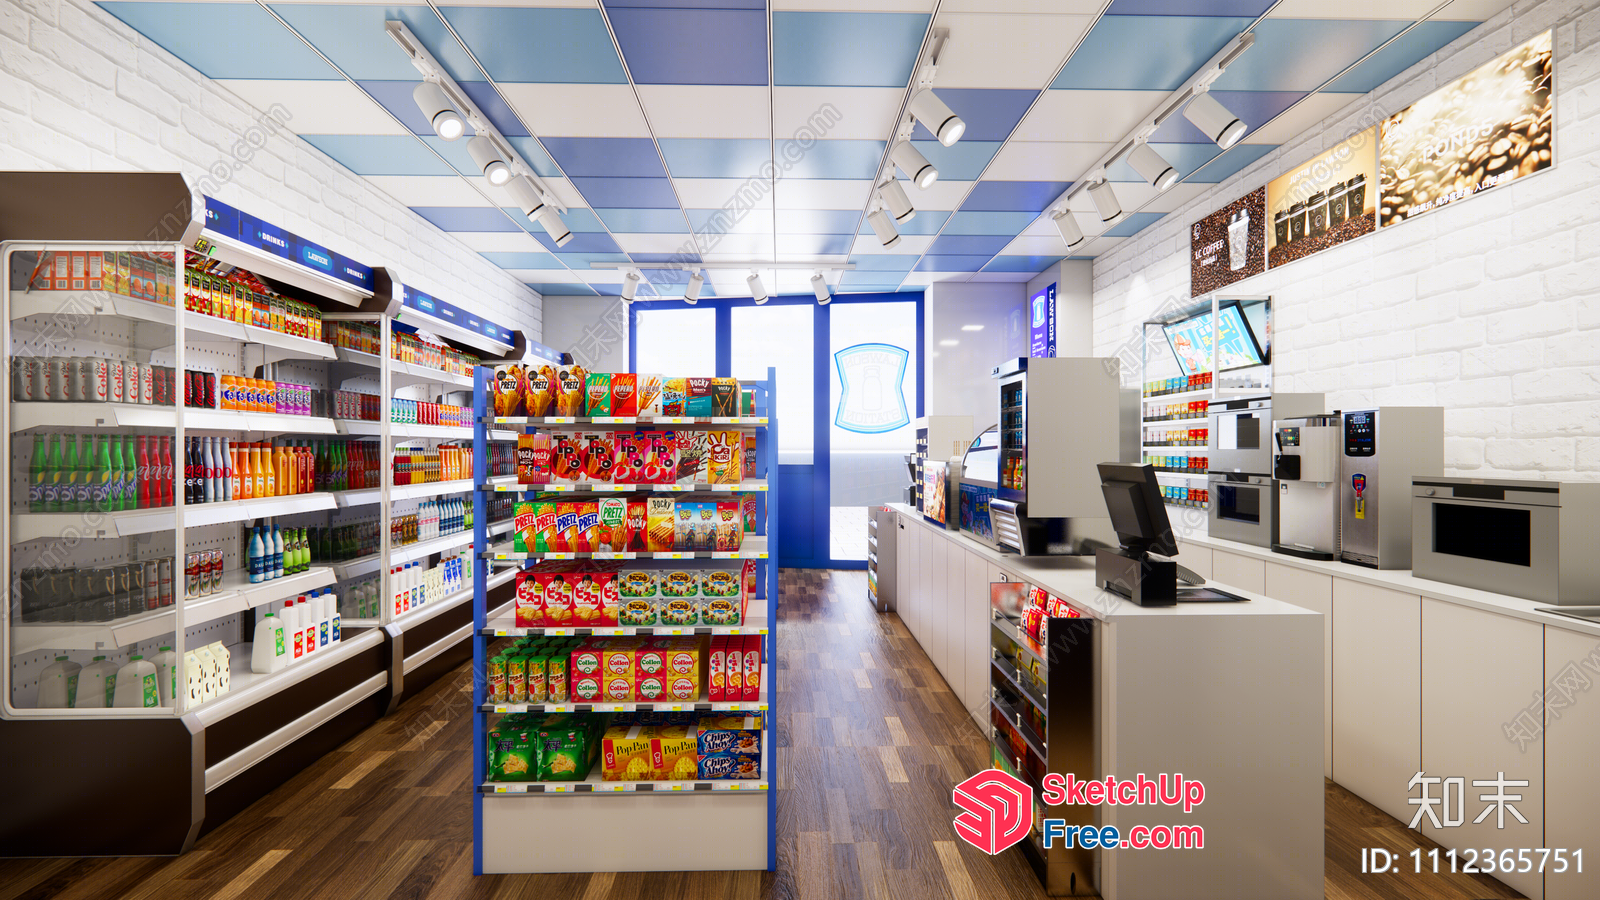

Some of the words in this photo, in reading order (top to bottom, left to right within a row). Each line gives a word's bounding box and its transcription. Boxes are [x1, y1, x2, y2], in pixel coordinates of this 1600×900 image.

[262, 232, 285, 248] DRINKS
[347, 267, 363, 280] DRINKS
[501, 381, 516, 390] PRETZ
[532, 381, 547, 390] PRETZ
[564, 381, 579, 390] PRETZ
[603, 507, 623, 519] PRETZ
[515, 514, 534, 531] PRETZ
[536, 514, 556, 531] PRETZ
[557, 514, 577, 531] PRETZ
[579, 514, 599, 531] PRETZ
[518, 587, 541, 605] ビスコ
[547, 587, 570, 605] ビスコ
[575, 587, 598, 605] ビスコ
[704, 731, 731, 744] Chips
[704, 756, 731, 769] Chips
